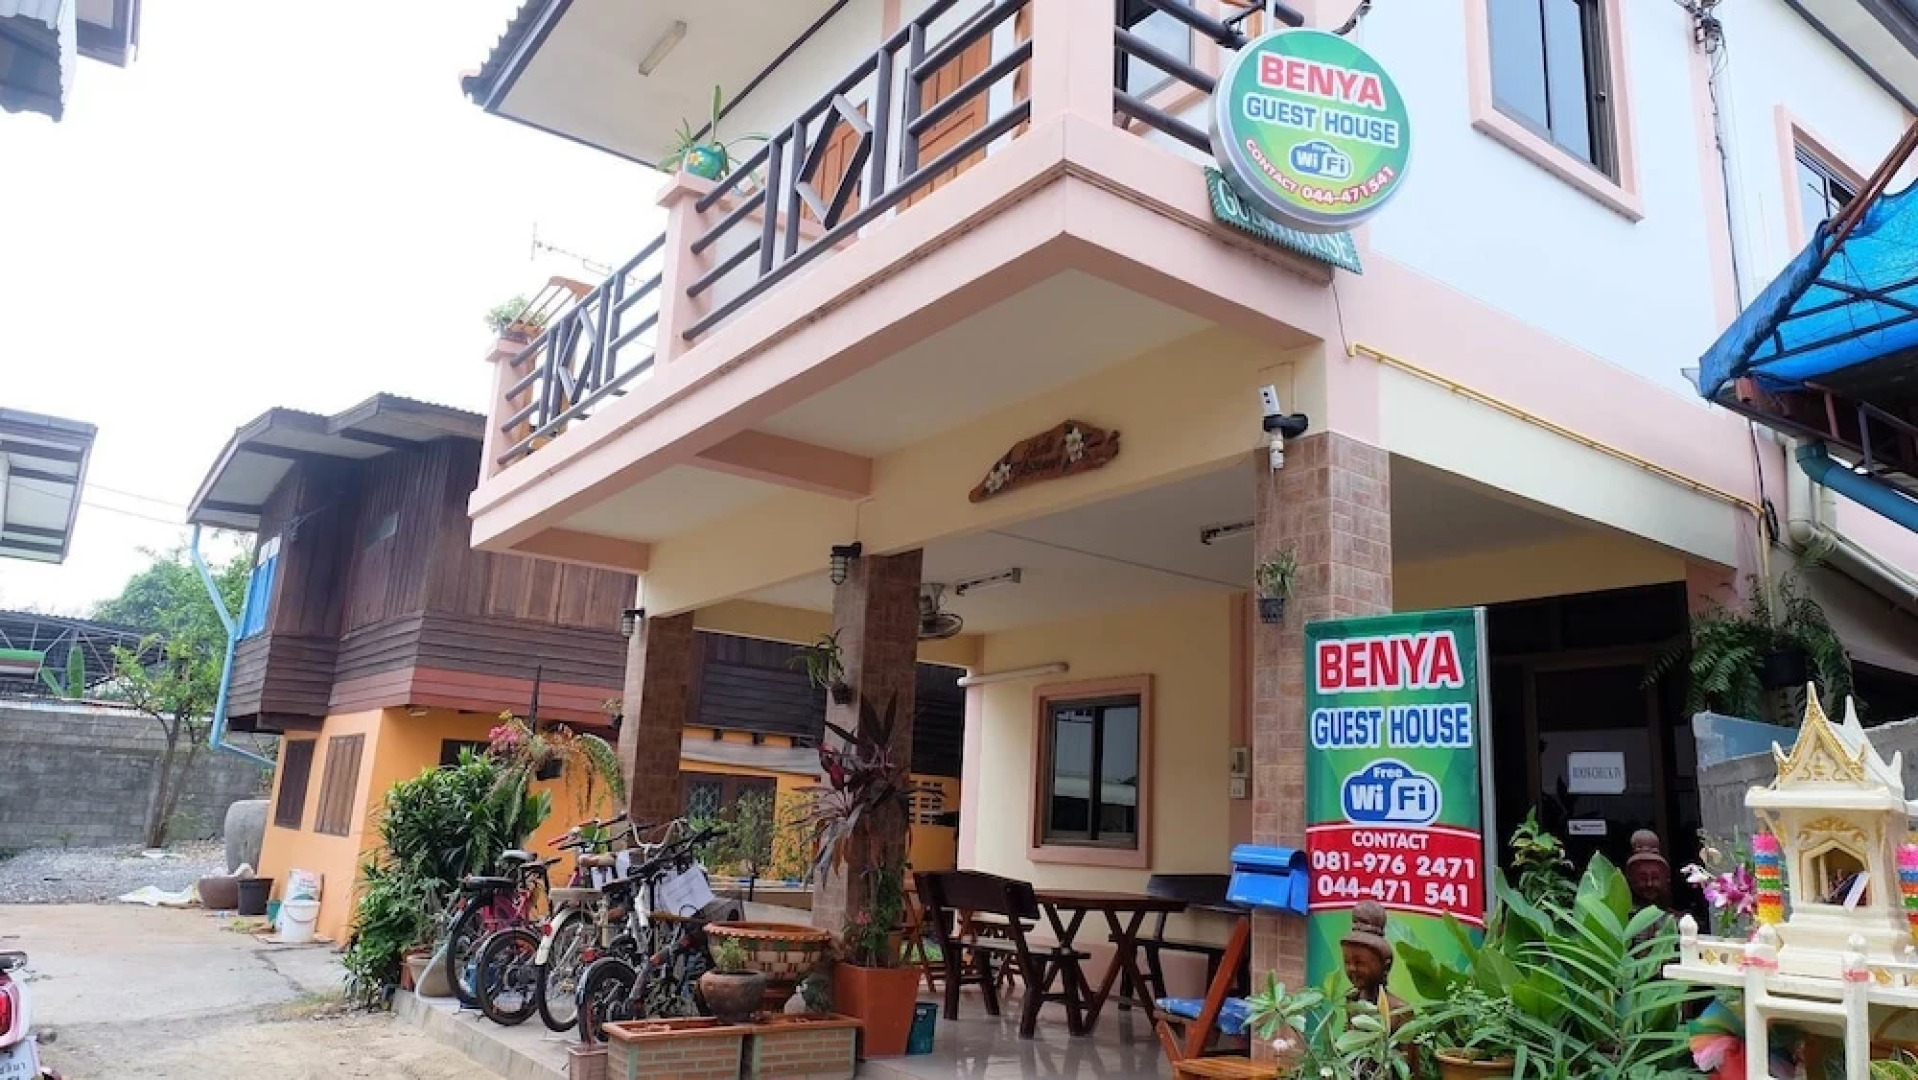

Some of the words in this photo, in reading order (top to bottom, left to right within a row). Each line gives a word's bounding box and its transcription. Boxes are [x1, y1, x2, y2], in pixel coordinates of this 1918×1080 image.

[1261, 54, 1383, 107] BENYA
[1246, 97, 1317, 128] GUEST
[1324, 111, 1396, 145] HOUSE
[1246, 139, 1299, 192] CONTACT
[1319, 635, 1460, 689] BENYA
[1313, 708, 1382, 746] GUEST
[1389, 706, 1469, 745] HOUSE
[1372, 766, 1403, 779] Free
[1351, 831, 1429, 850] CONTACT
[1312, 850, 1407, 876] 081-976
[1415, 855, 1476, 880] 2471
[1317, 874, 1411, 903] 044-471
[1424, 881, 1469, 908] 541
